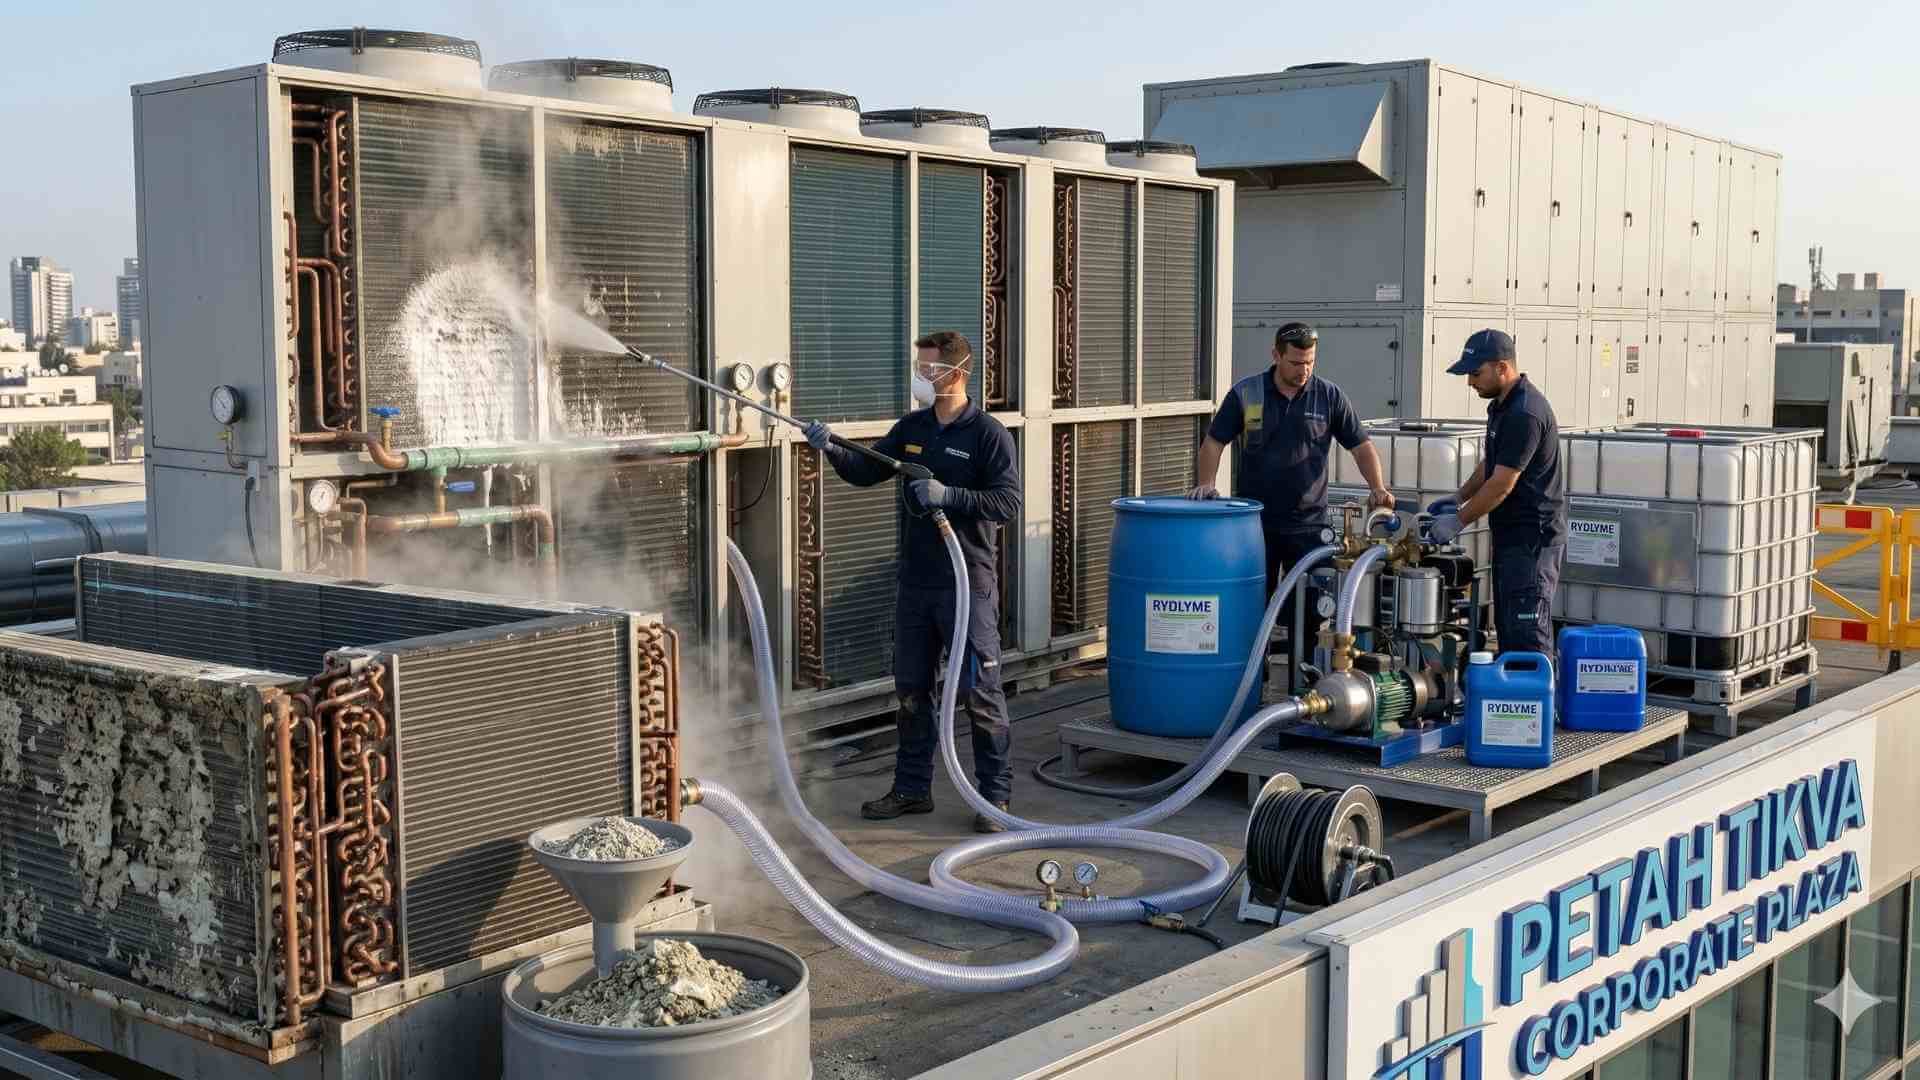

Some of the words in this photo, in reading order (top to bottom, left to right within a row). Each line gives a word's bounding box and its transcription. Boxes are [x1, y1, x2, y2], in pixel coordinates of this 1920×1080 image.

[1571, 522, 1615, 533] RYDLYME
[1152, 600, 1212, 613] RYDLYME
[1488, 703, 1537, 714] RYDLYME
[1500, 822, 1713, 1006] PETAH
[1720, 758, 1865, 891] TIKVA
[1516, 904, 1755, 1076] CORPORATE
[1757, 851, 1862, 943] PLAZA
